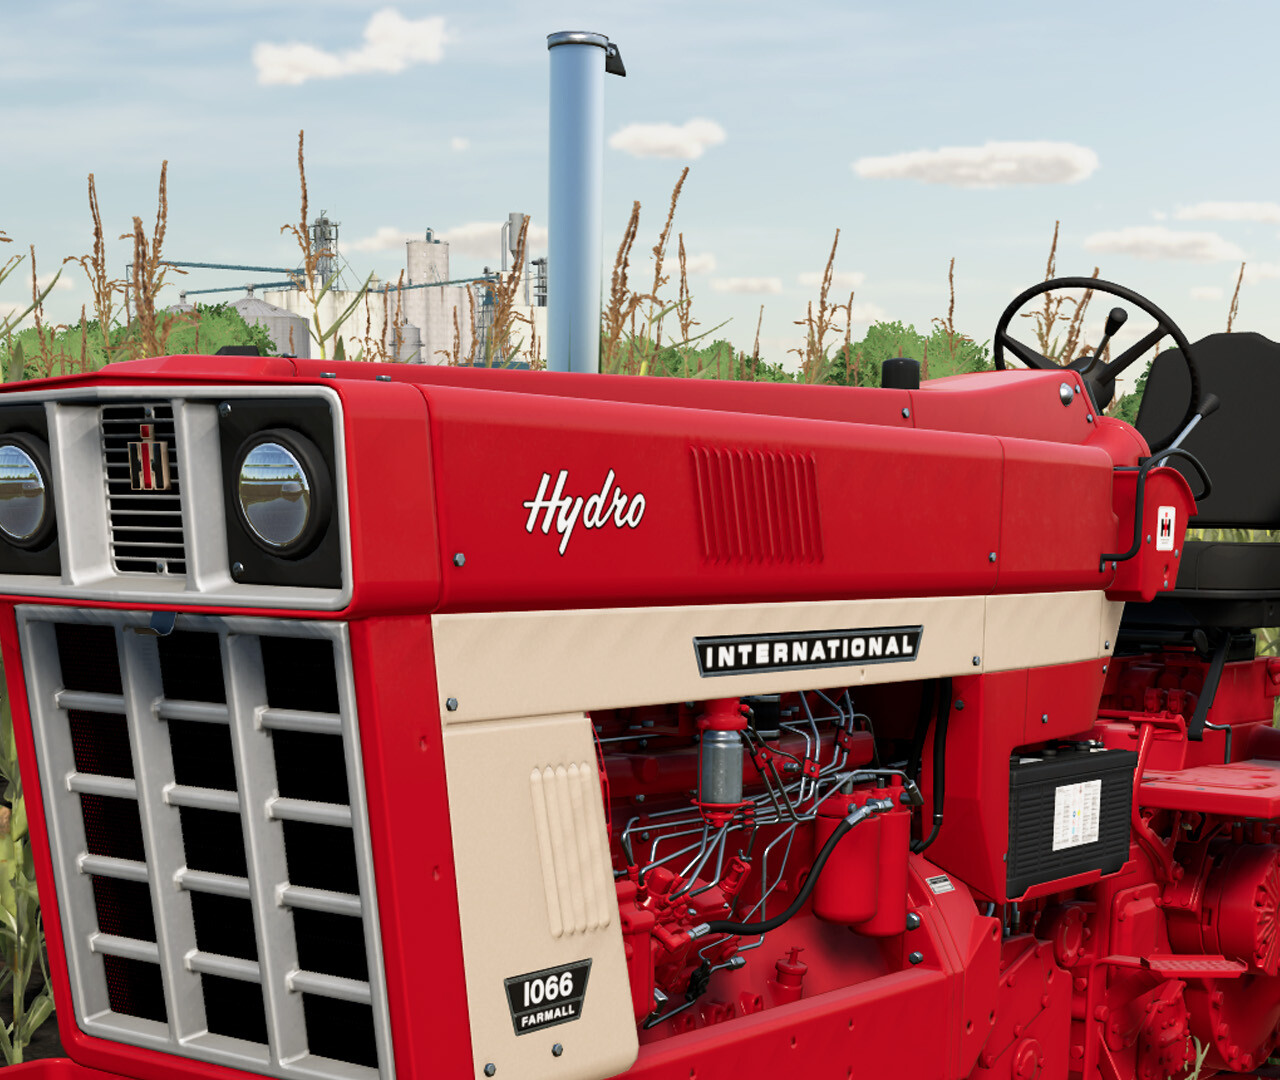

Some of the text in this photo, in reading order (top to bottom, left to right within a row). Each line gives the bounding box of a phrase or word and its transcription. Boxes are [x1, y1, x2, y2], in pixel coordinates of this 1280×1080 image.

[522, 467, 646, 557] Hydro
[706, 635, 913, 669] INTERNATIONAL
[523, 971, 574, 1007] 1066
[521, 1004, 575, 1028] FARMALL
